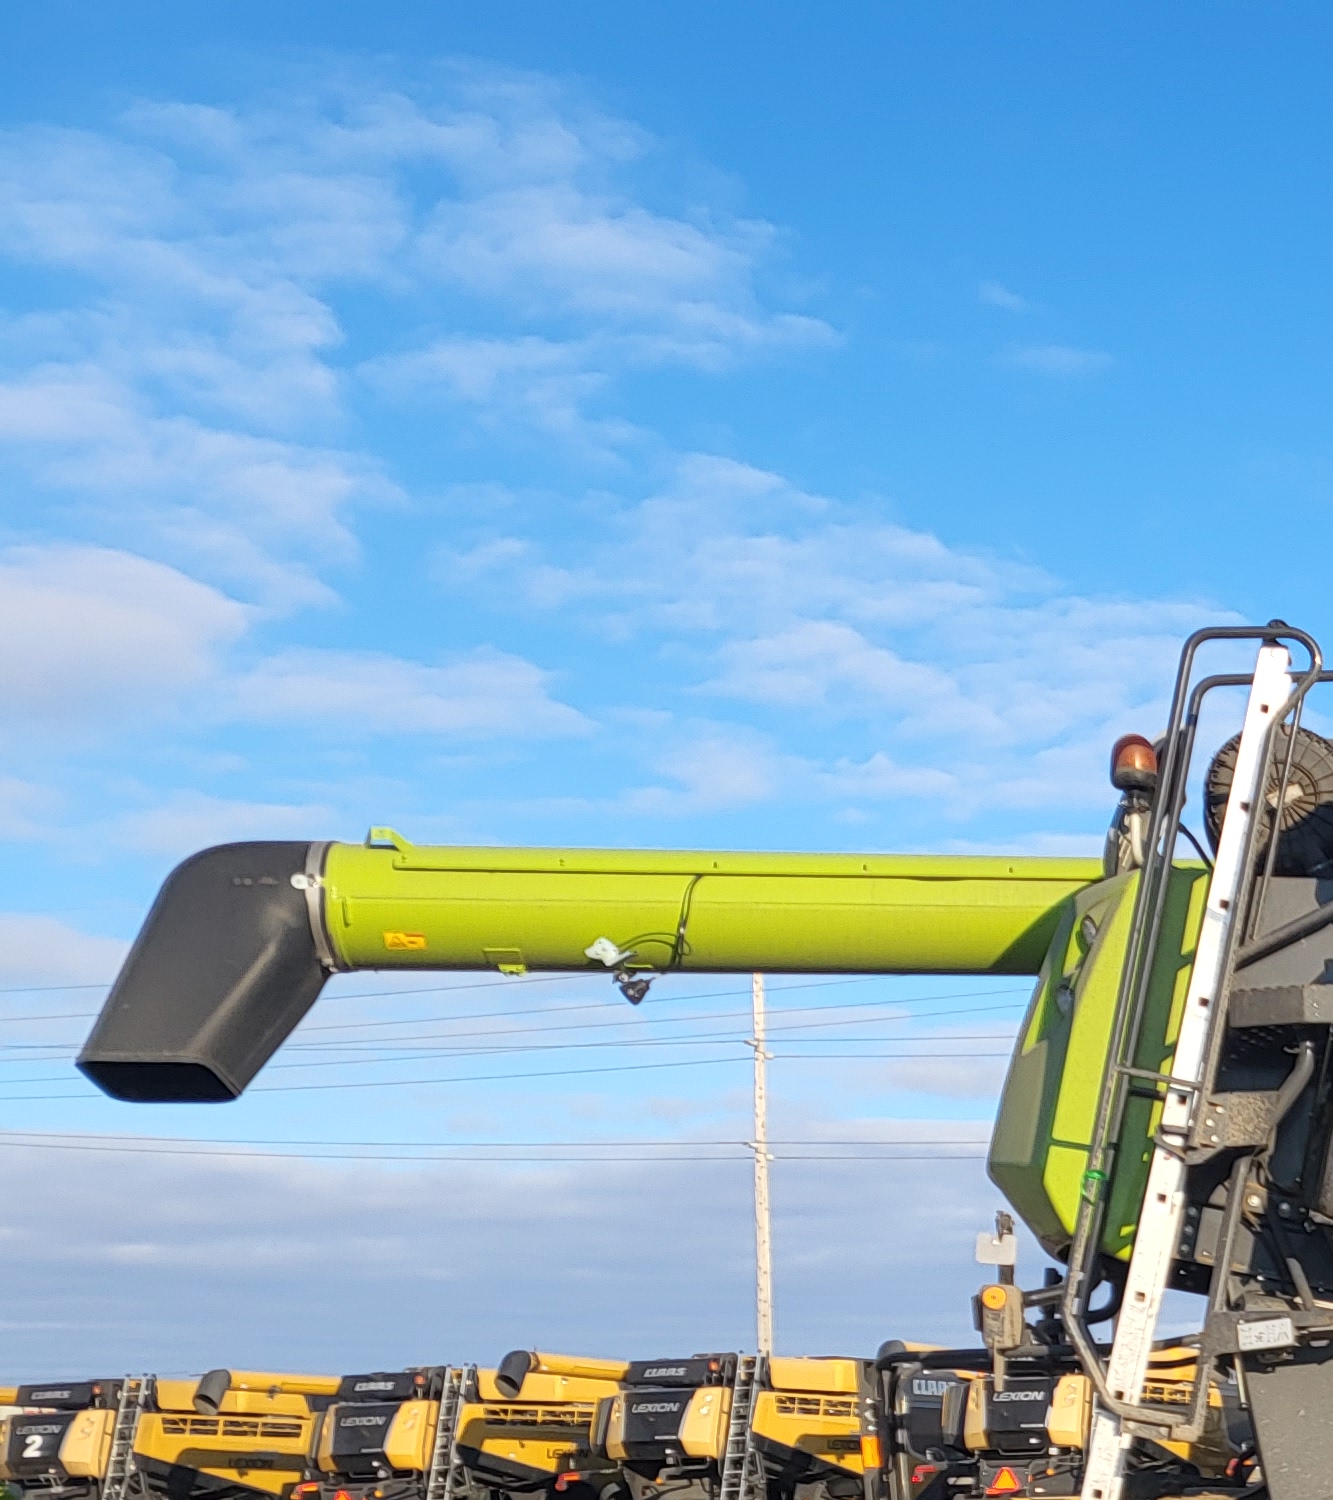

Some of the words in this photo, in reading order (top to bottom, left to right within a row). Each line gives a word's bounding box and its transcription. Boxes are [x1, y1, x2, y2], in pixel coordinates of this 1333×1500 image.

[913, 1379, 955, 1396] CLAA
[993, 1391, 1045, 1402] LEXION
[632, 1403, 680, 1413] LEXION
[340, 1416, 387, 1427] LEXION
[22, 1435, 44, 1458] 2
